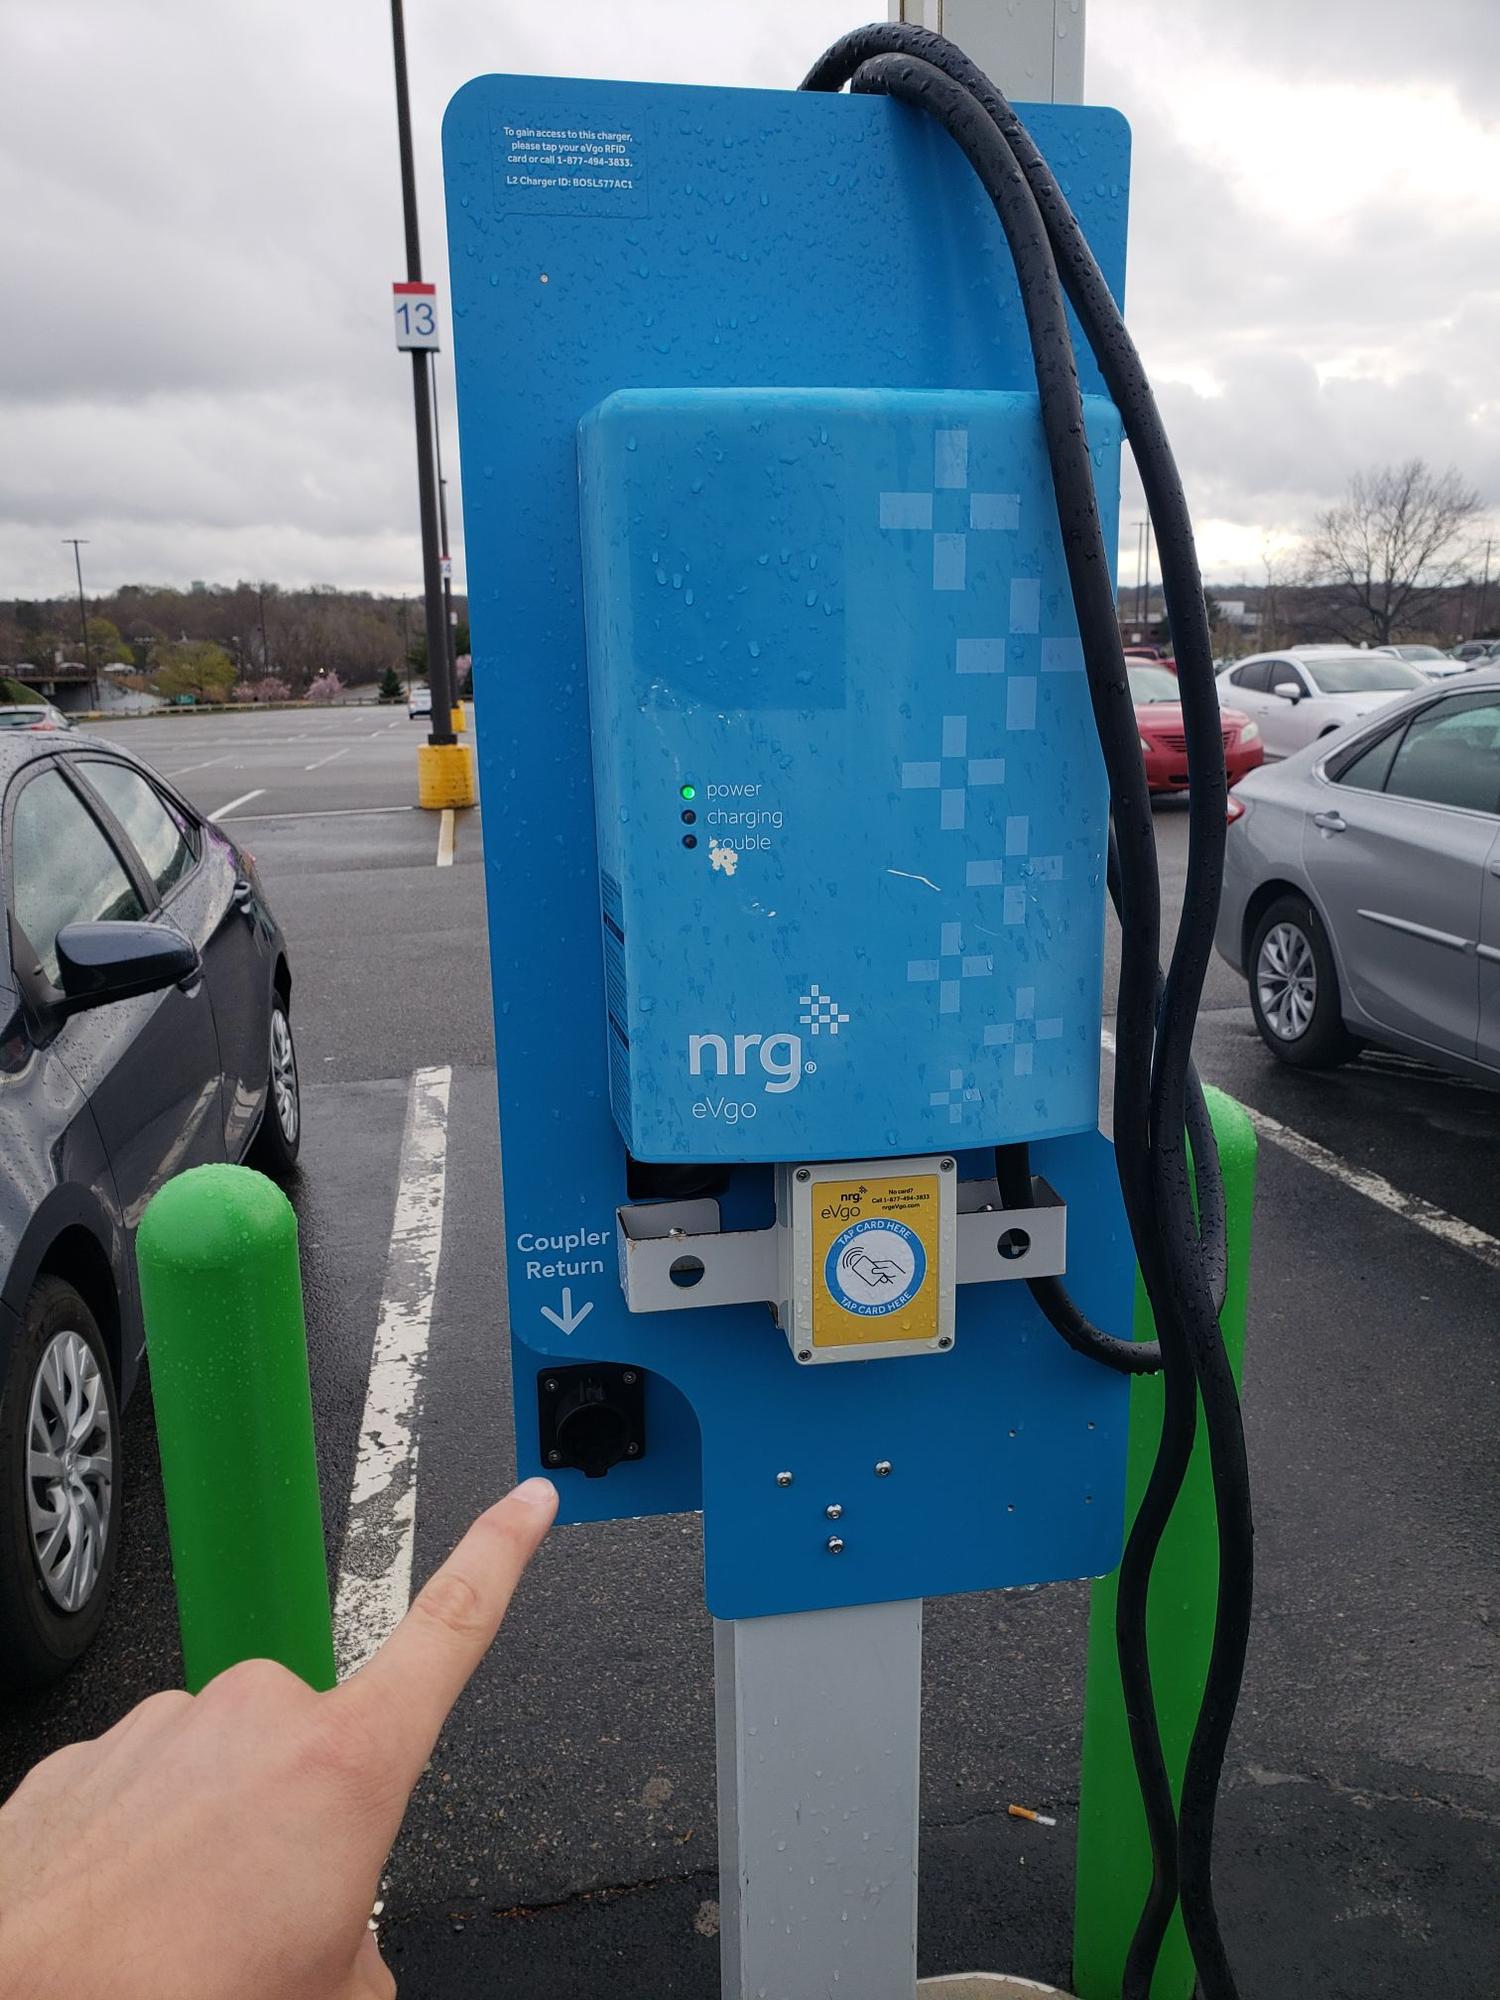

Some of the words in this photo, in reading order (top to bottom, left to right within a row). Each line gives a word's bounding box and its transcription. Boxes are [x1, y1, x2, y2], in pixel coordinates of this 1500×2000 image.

[503, 127, 514, 136] To
[516, 128, 535, 138] gain
[536, 130, 566, 139] access
[567, 130, 577, 139] to
[579, 130, 596, 140] this
[597, 131, 633, 143] charger,
[511, 140, 540, 151] please
[542, 142, 557, 152] tap
[559, 144, 578, 153] your
[580, 144, 603, 155] eVgo
[604, 144, 626, 154] RFID
[507, 154, 527, 163] card
[528, 155, 539, 163] or
[540, 155, 555, 164] call
[556, 156, 633, 167] 1-877-494-3833.
[506, 176, 518, 185] L2
[520, 176, 556, 187] Charger
[558, 178, 571, 187] ID:
[397, 302, 435, 335] 13
[707, 784, 762, 800] power
[707, 808, 783, 829] charging
[709, 834, 771, 850] ouble
[692, 1096, 757, 1125] eVgo
[821, 1204, 861, 1221] eVgo
[517, 1227, 610, 1253] Coupler
[837, 1229, 855, 1246] TAP
[856, 1220, 885, 1232] CARD
[886, 1221, 912, 1239] HERE
[526, 1260, 604, 1280] Return
[840, 1296, 857, 1310] TAP
[858, 1305, 886, 1315] CARD
[888, 1291, 912, 1311] HERE
